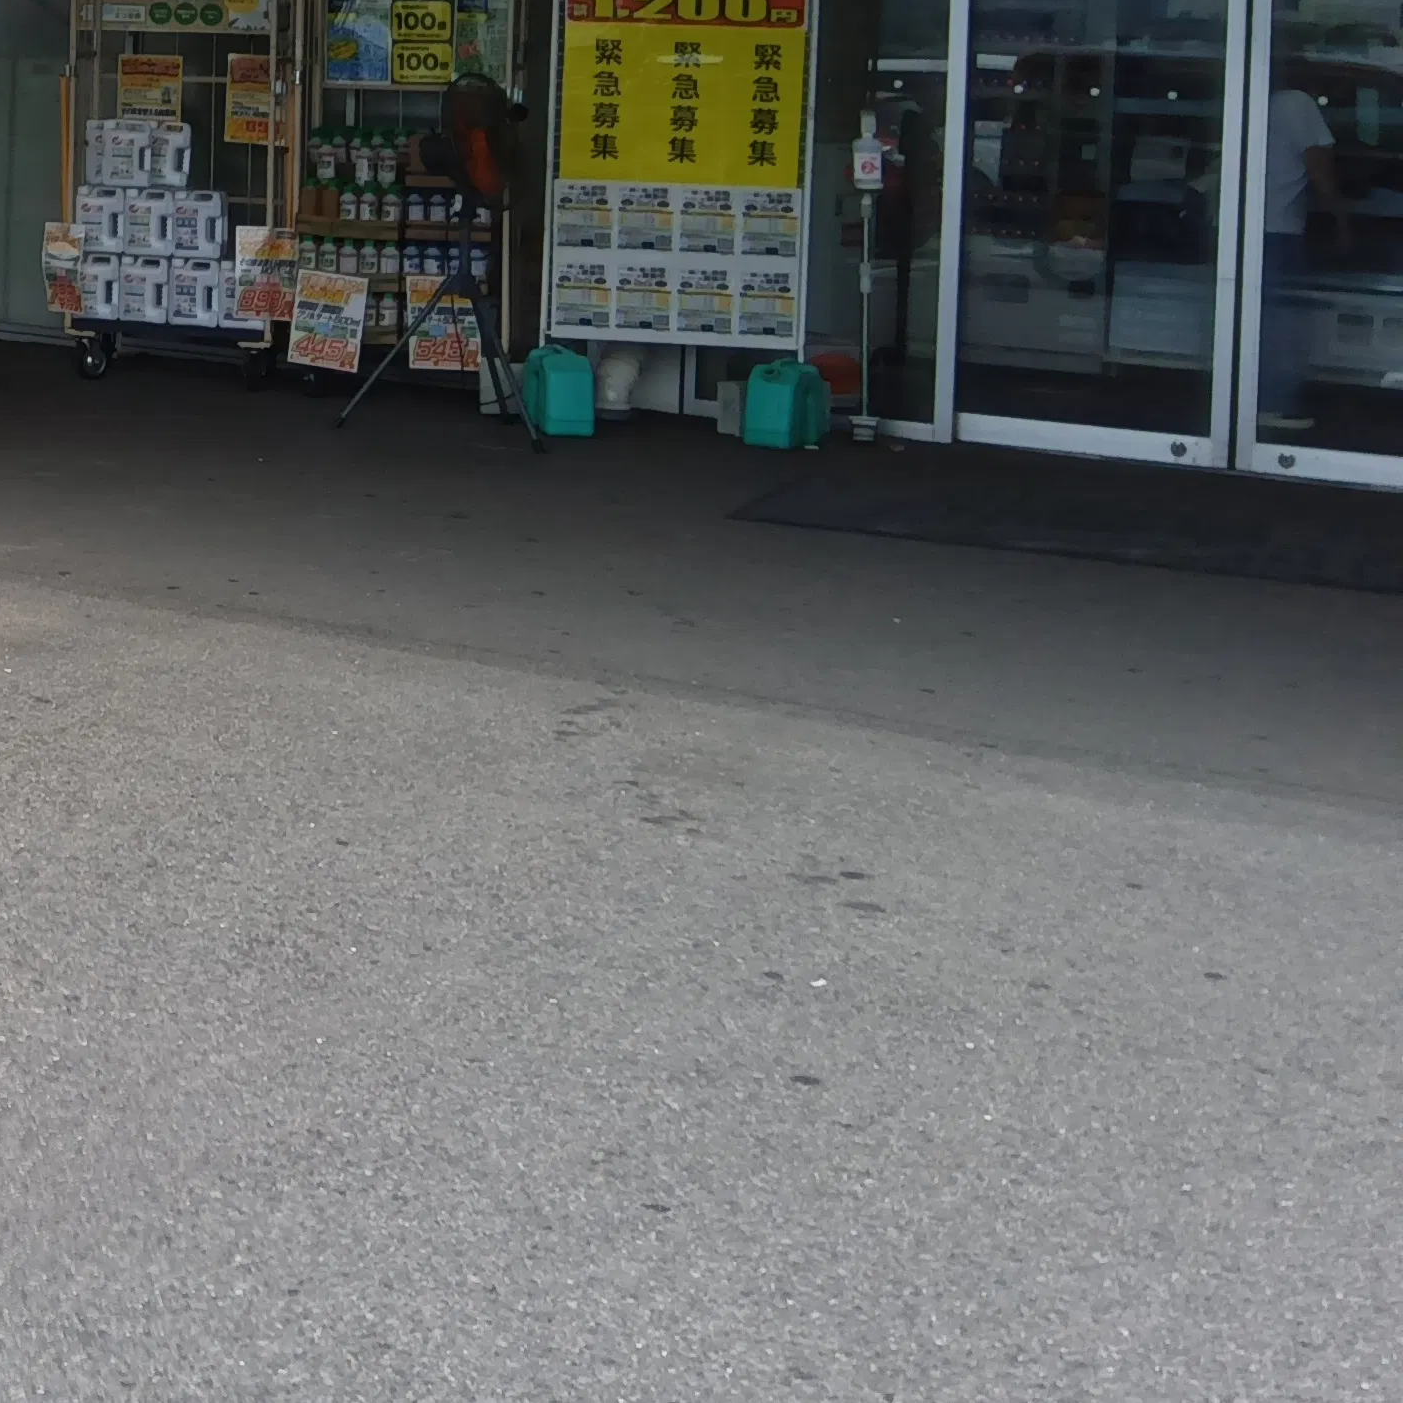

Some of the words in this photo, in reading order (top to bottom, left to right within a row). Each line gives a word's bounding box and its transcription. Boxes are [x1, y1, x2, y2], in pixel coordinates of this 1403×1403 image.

[590, 38, 623, 160] 緊急募集
[667, 41, 702, 164] 緊急募集
[747, 44, 782, 166] 緊急募集
